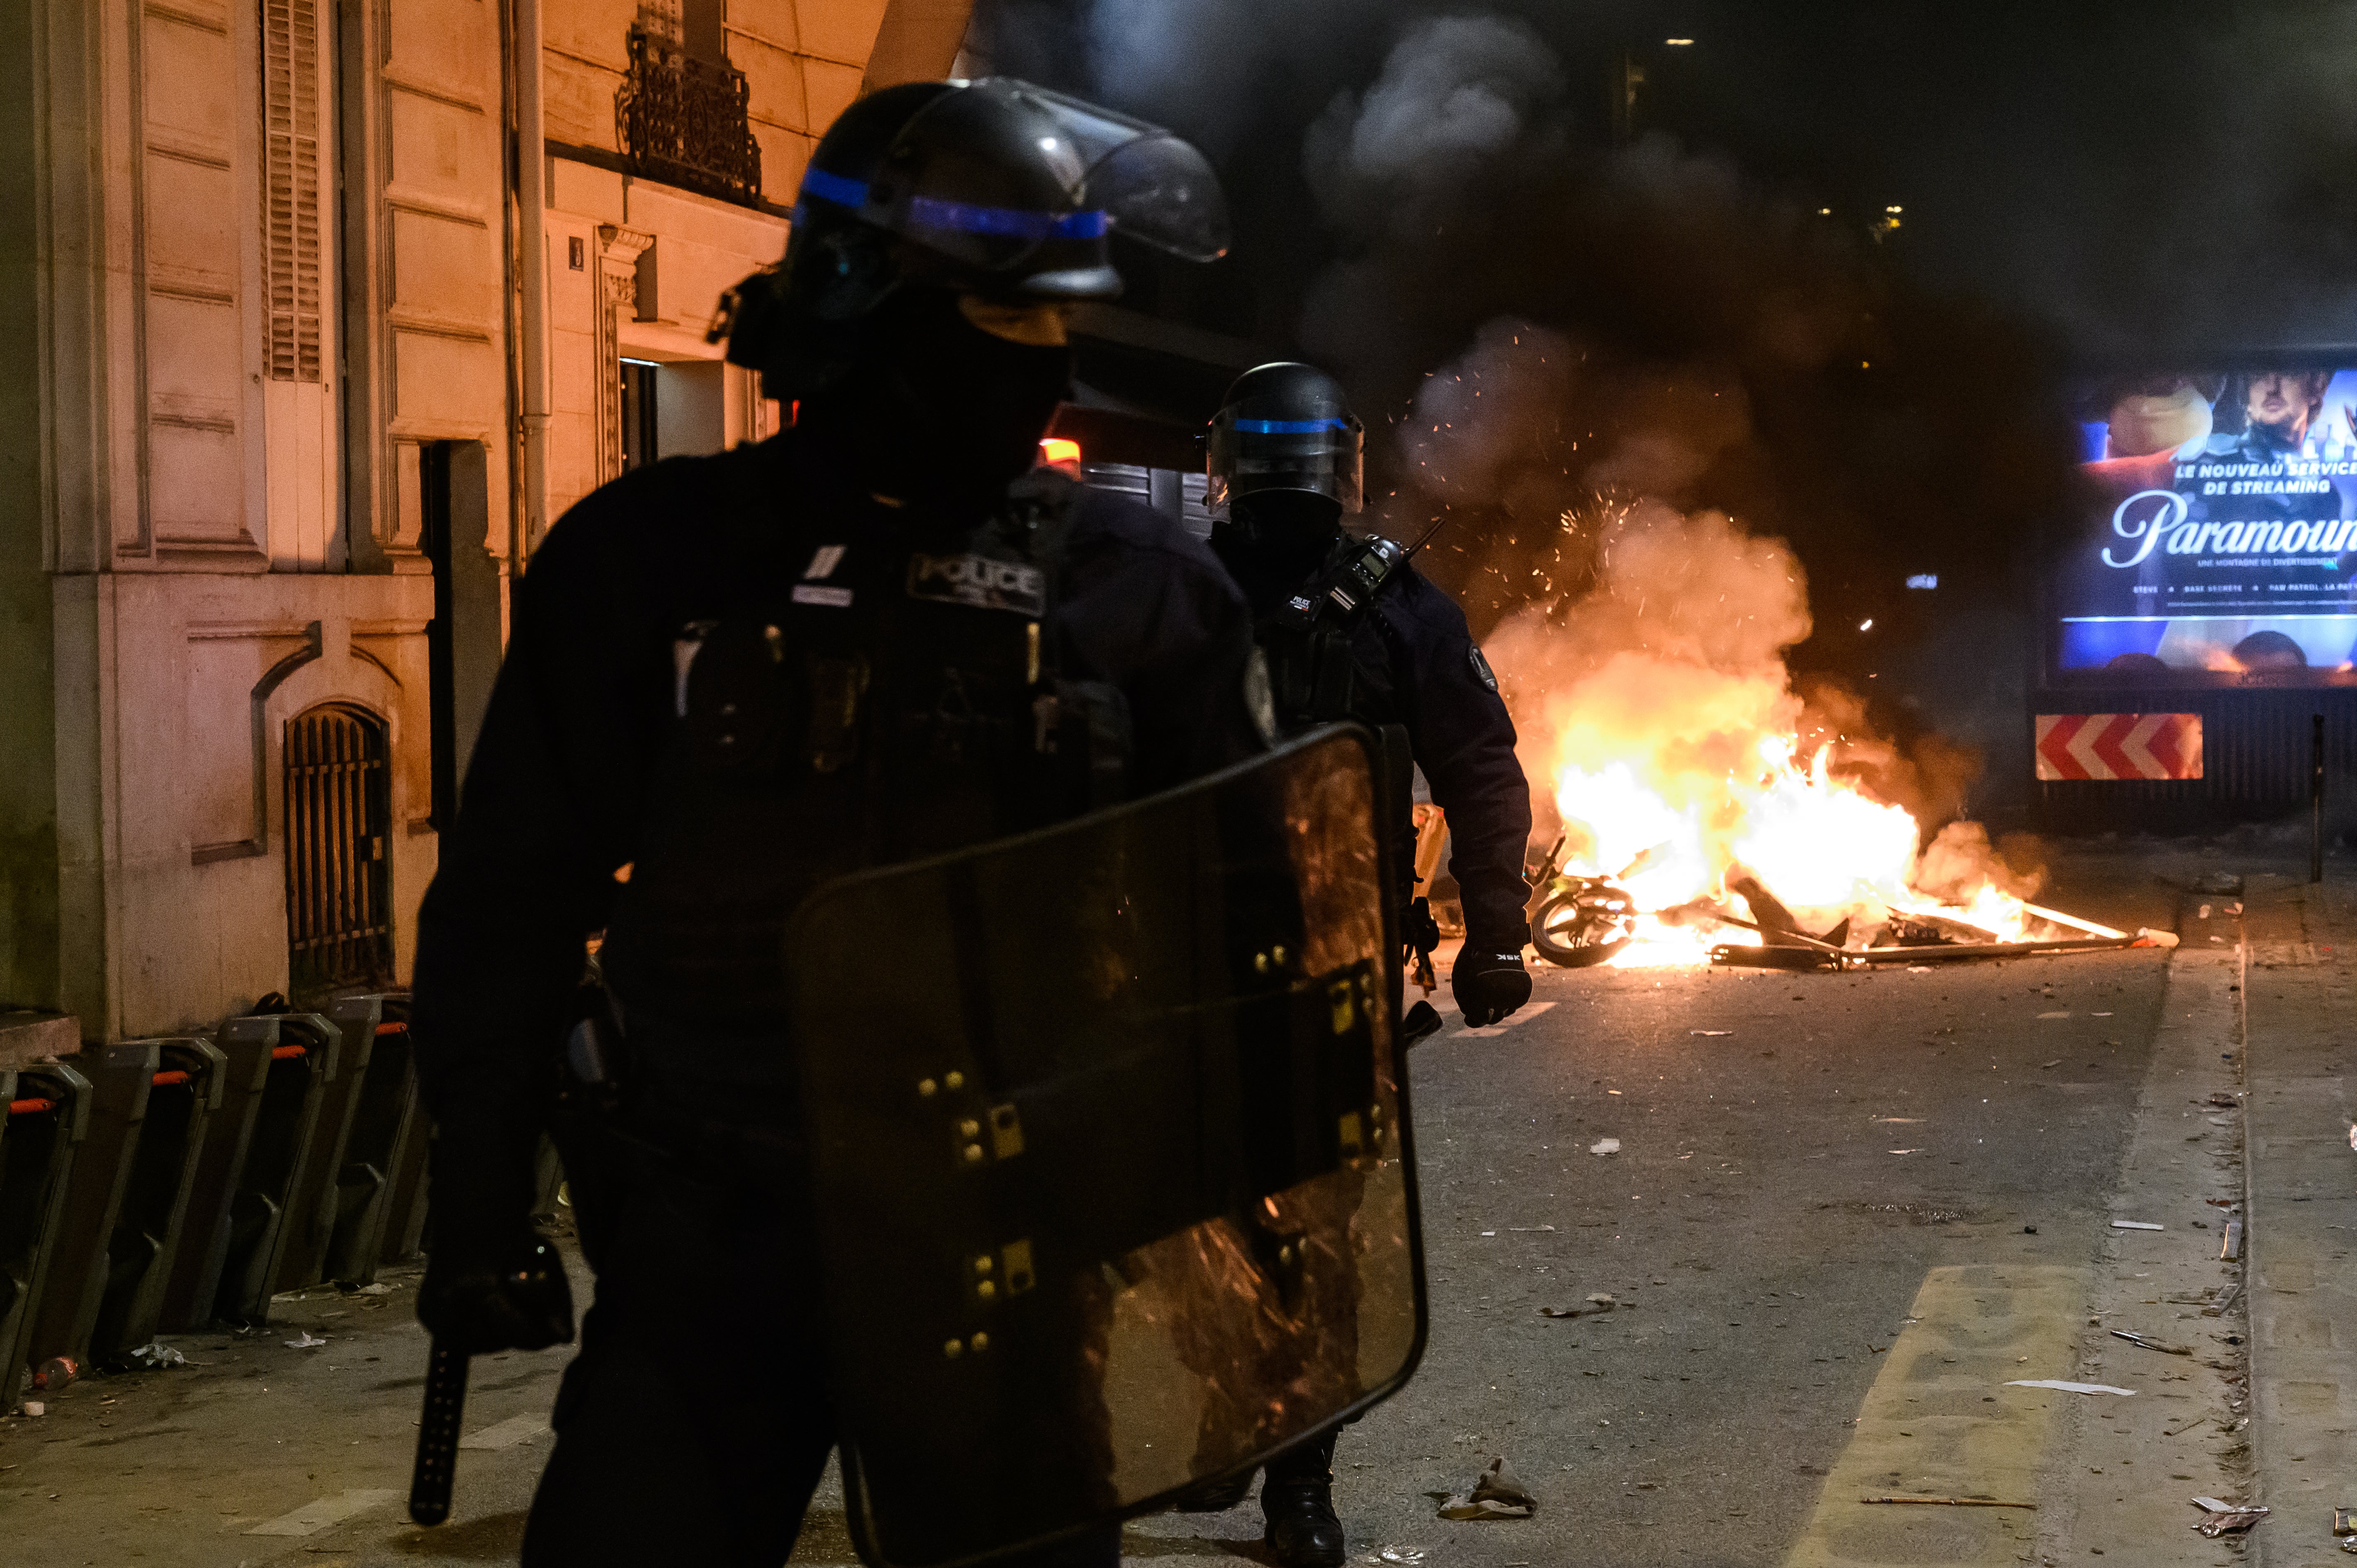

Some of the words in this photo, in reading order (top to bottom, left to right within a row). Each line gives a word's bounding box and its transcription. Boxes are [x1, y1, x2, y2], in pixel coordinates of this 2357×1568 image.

[2175, 465, 2196, 478] LE
[2199, 463, 2283, 478] NOUVEAU
[2288, 462, 2357, 476] SERVICE
[2203, 481, 2228, 495] DE
[2231, 479, 2331, 495] STREAMING
[1293, 595, 1311, 606] POLICE
